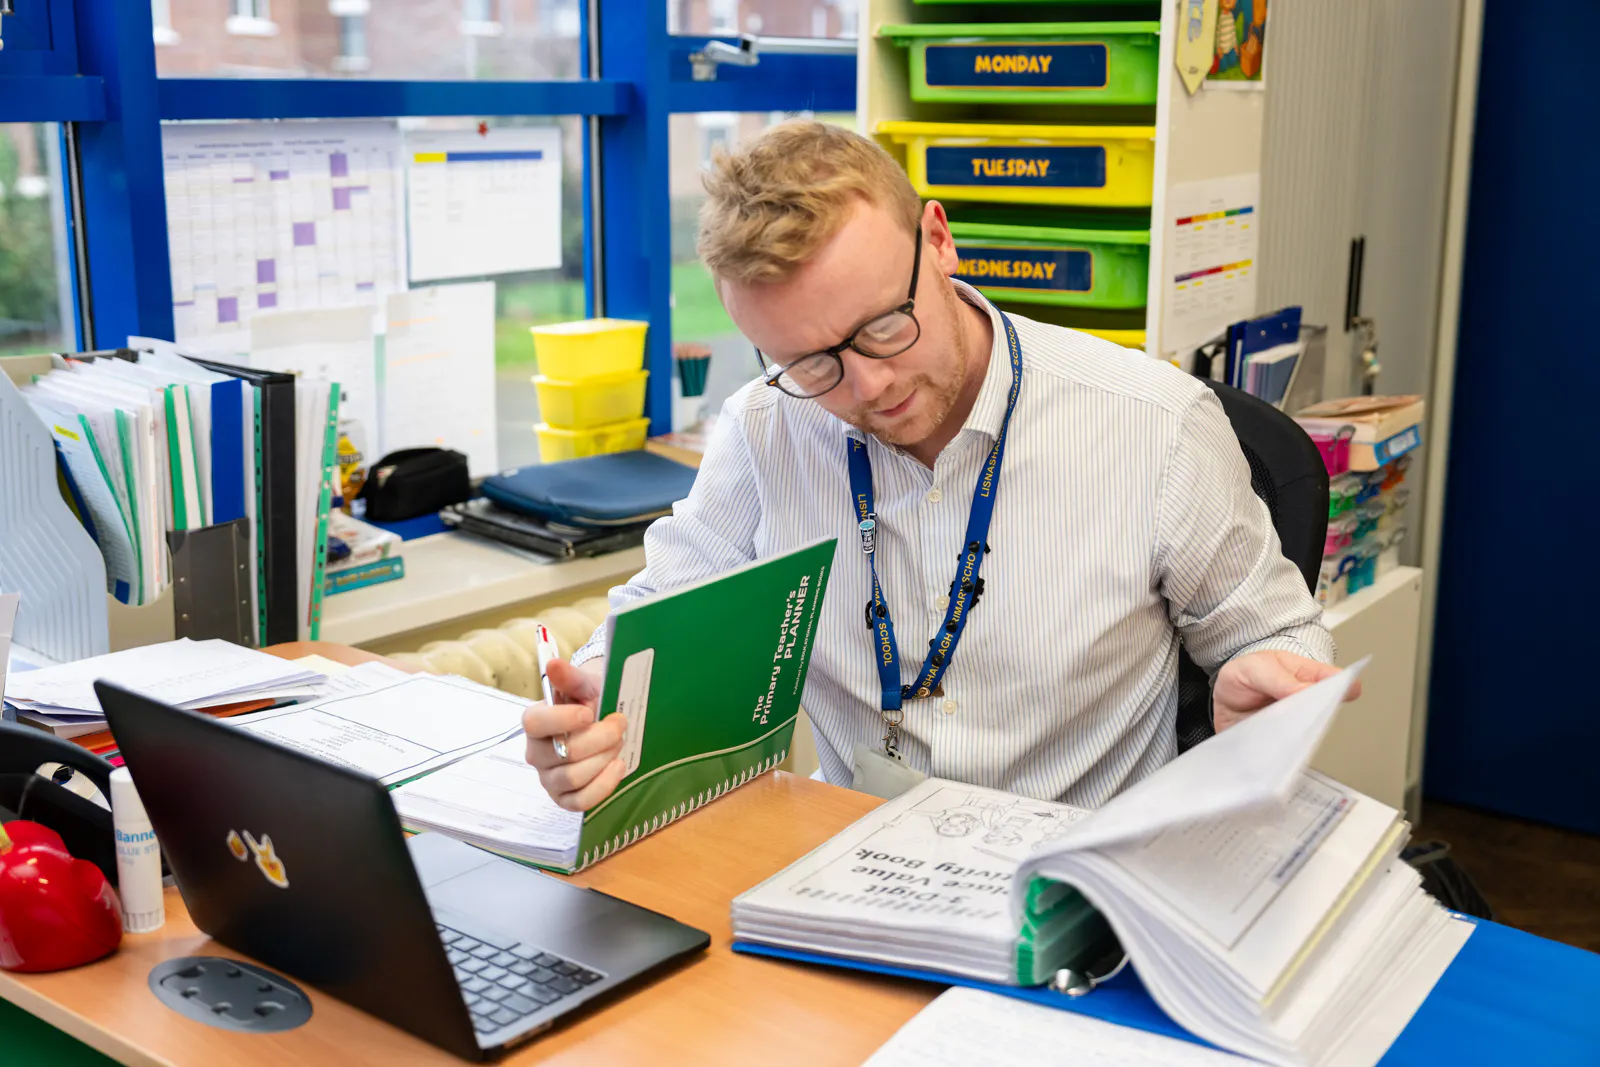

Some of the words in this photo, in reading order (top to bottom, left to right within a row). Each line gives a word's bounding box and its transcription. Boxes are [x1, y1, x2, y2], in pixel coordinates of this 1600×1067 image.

[974, 55, 1053, 74] MONDAY
[971, 158, 1050, 177] TUESDAY
[956, 258, 1057, 279] WEDNESDAY
[1007, 325, 1020, 366] SCHOOL
[784, 575, 811, 660] PLANNER
[878, 622, 893, 667] SCHOOL
[760, 665, 781, 725] Primary
[773, 590, 797, 663] Teacher's
[752, 695, 765, 722] The
[115, 828, 157, 843] Banne
[855, 848, 927, 869] Book
[851, 866, 931, 886] Value
[865, 884, 972, 904] 3-Digit
[942, 880, 1009, 895] lace
